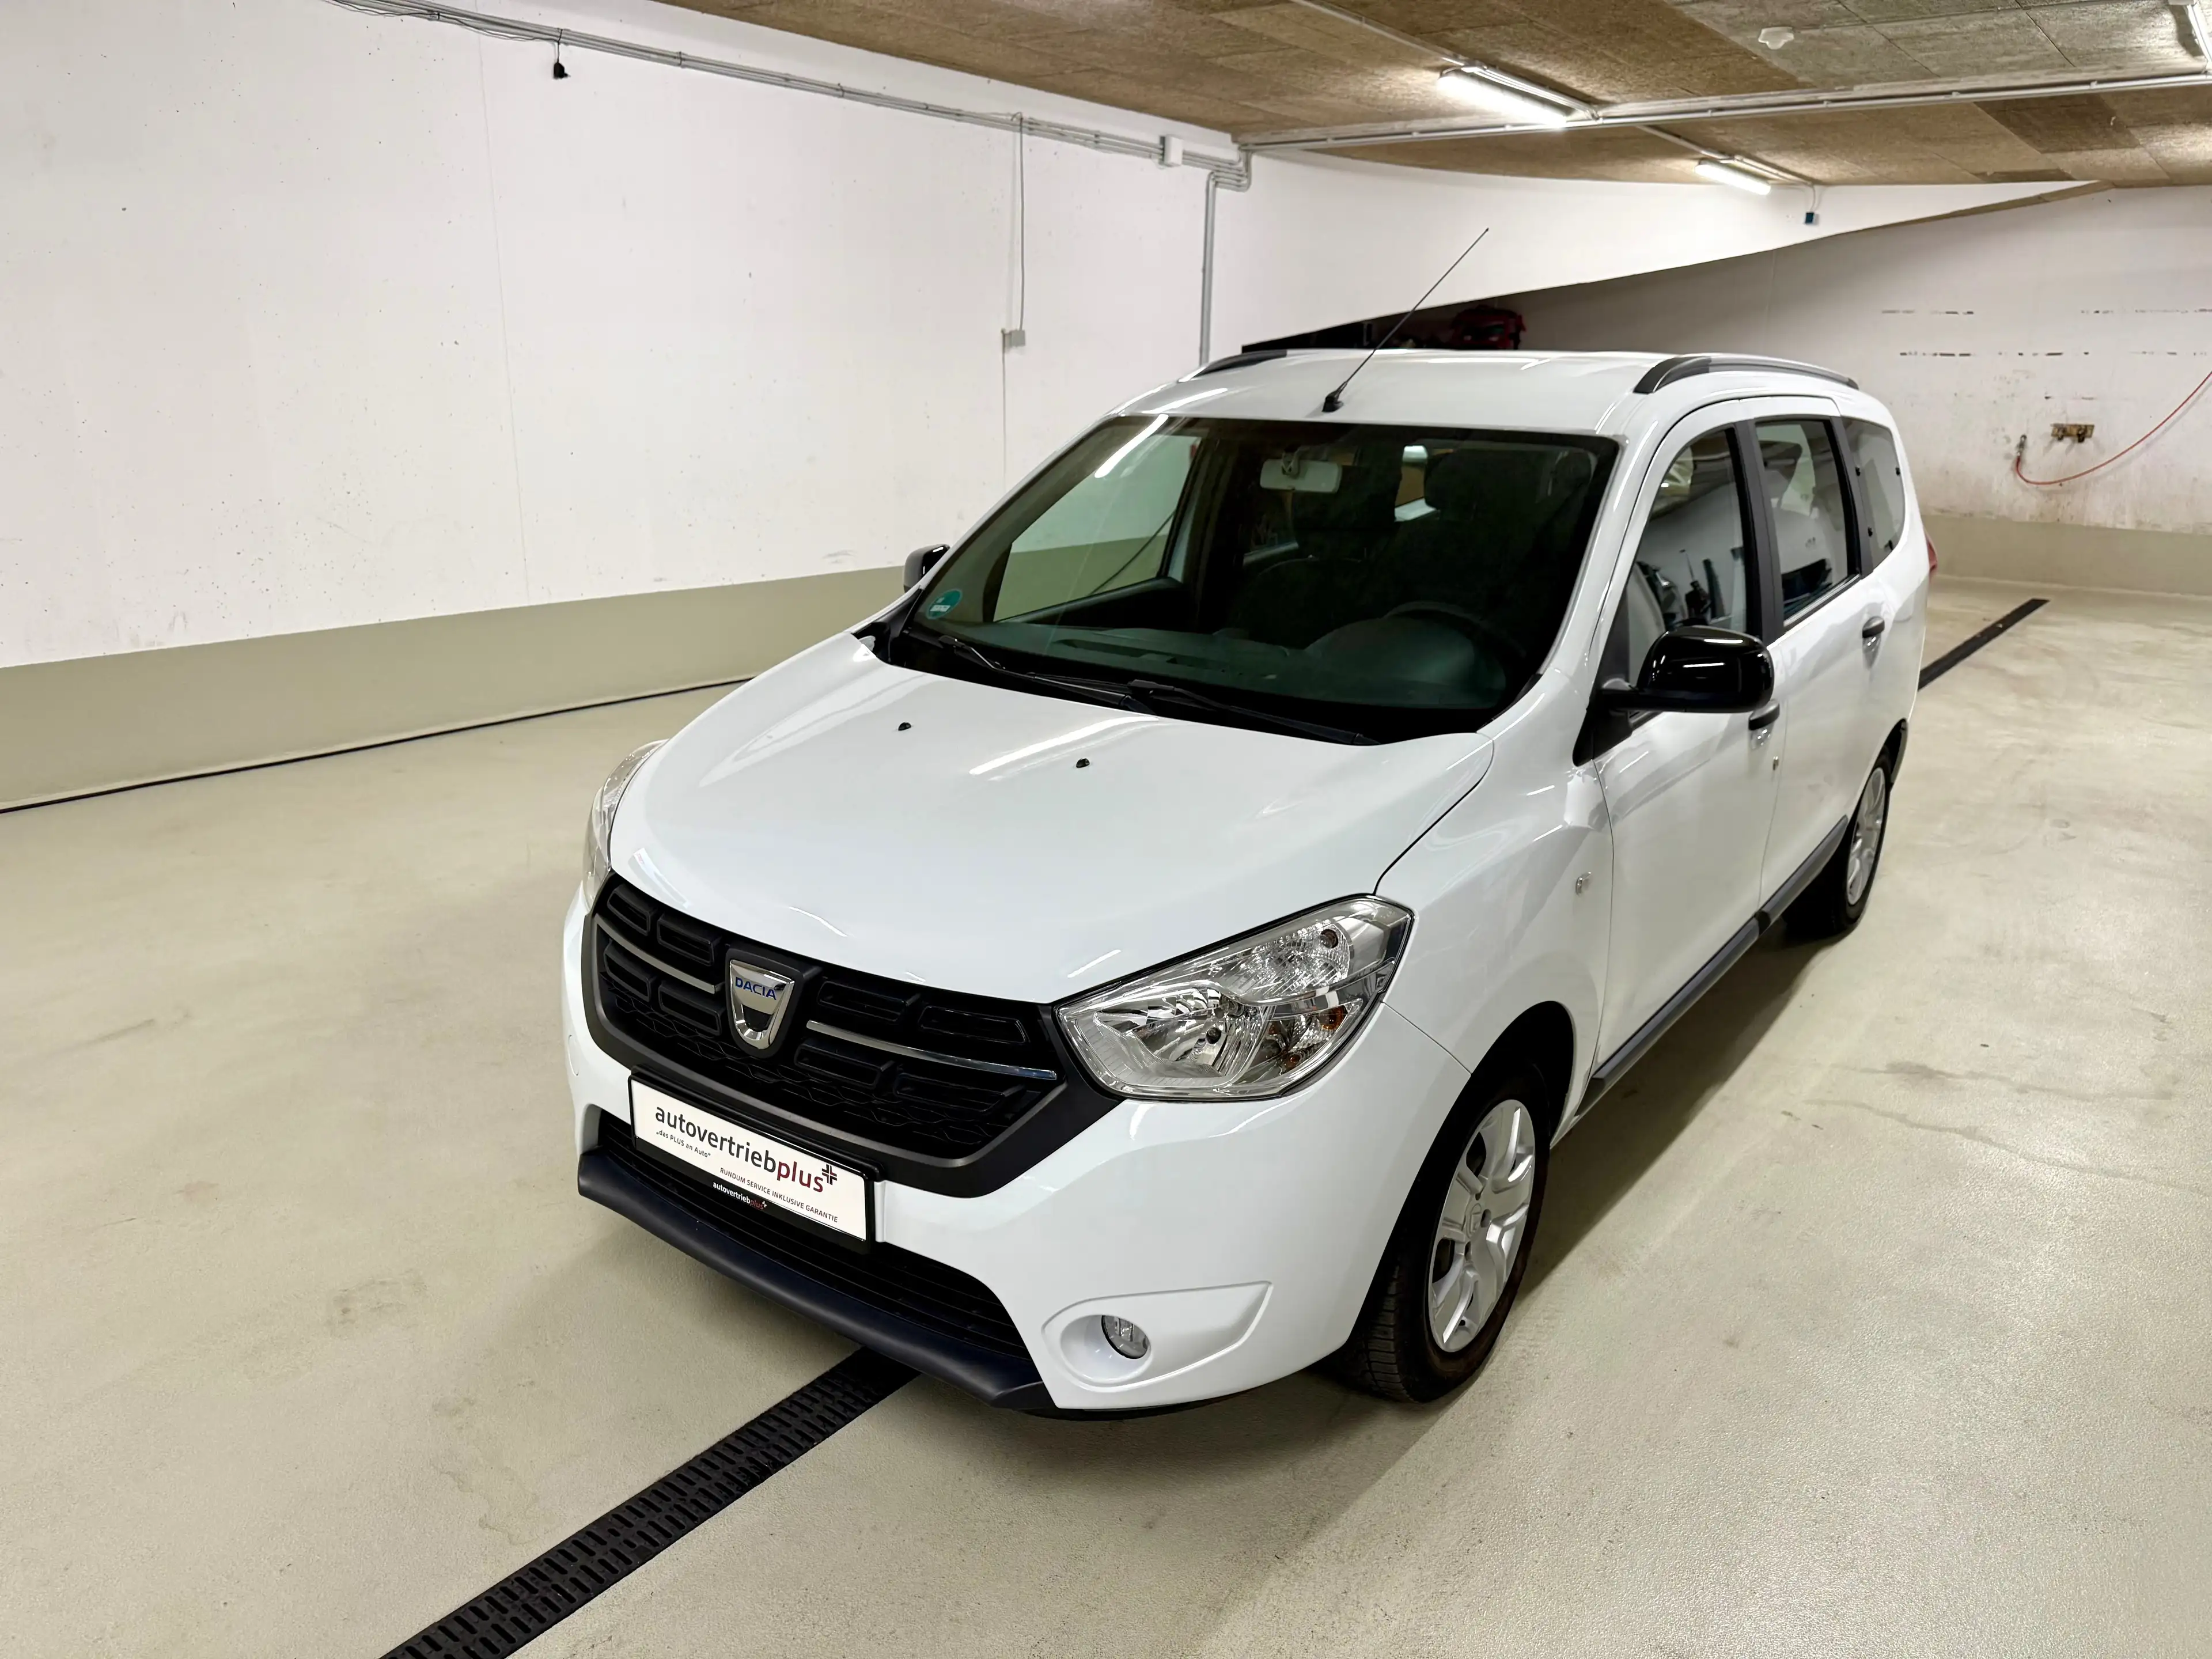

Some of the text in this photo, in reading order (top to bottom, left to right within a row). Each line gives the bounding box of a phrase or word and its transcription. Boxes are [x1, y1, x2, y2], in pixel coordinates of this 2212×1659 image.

[735, 976, 777, 1000] DACIA
[670, 1134, 684, 1146] PLUS
[719, 1167, 839, 1223] RUNDUM SERVICE INKLUSIVE GARANTIE
